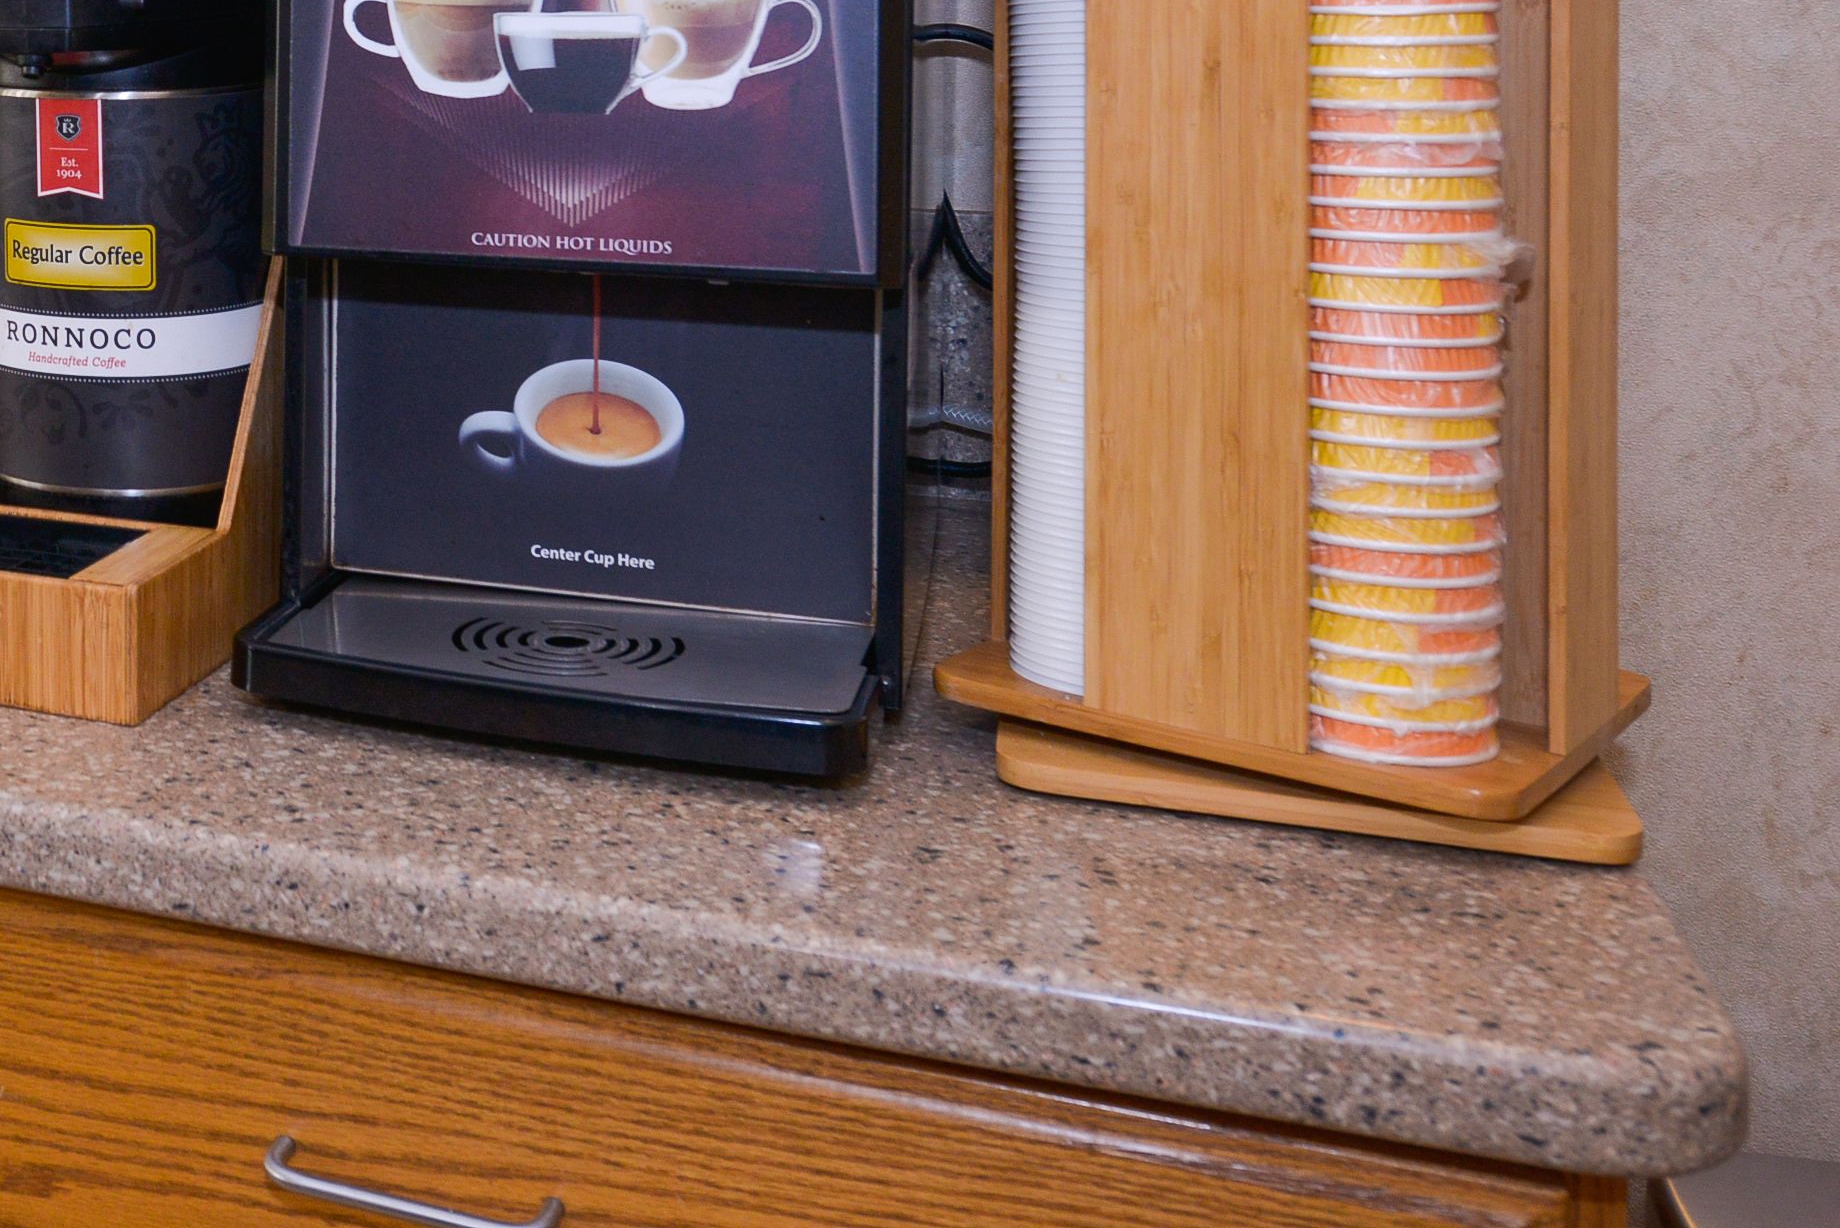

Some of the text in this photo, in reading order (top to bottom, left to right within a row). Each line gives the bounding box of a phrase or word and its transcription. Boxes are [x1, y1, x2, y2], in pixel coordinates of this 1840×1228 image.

[62, 122, 75, 134] R
[61, 156, 79, 168] Est.
[56, 169, 82, 180] 1904
[13, 239, 144, 266] Regular Coffee
[471, 232, 673, 255] CAUTION HOT LIQUIDS
[7, 319, 156, 349] RONNOCO
[28, 351, 126, 370] Handcrafted Coffee
[530, 544, 655, 570] Center Cup Here
